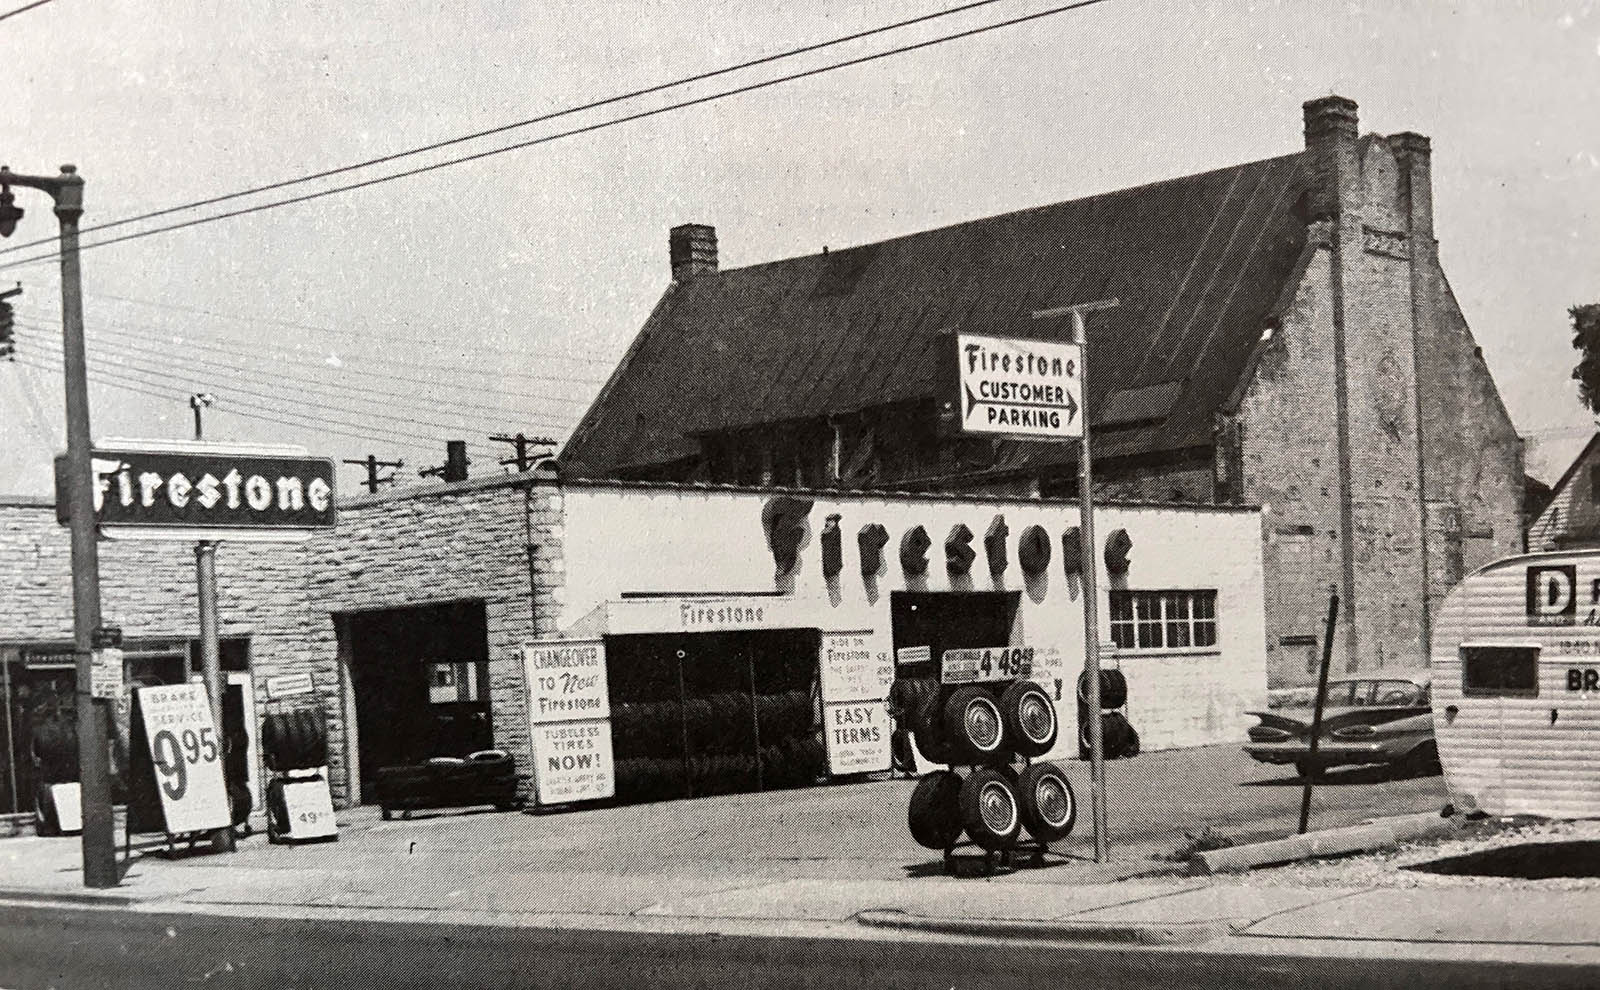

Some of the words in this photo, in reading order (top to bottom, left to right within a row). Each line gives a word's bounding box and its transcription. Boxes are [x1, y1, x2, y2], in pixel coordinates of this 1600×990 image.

[964, 343, 1075, 378] Firestone
[980, 380, 1064, 403] CUSTOMER
[987, 406, 1060, 428] PARKING
[91, 458, 331, 512] Firestone
[1535, 570, 1571, 613] D
[679, 603, 764, 626] Firestone
[533, 647, 599, 670] CHANGEOVER
[538, 676, 555, 690] TO
[1567, 669, 1600, 691] BR
[538, 697, 601, 714] Firestone
[835, 708, 874, 726] EASY
[544, 727, 600, 740] TUBELESS
[833, 726, 881, 745] TERMS
[552, 739, 594, 752] TIRES
[548, 753, 600, 772] NOW!
